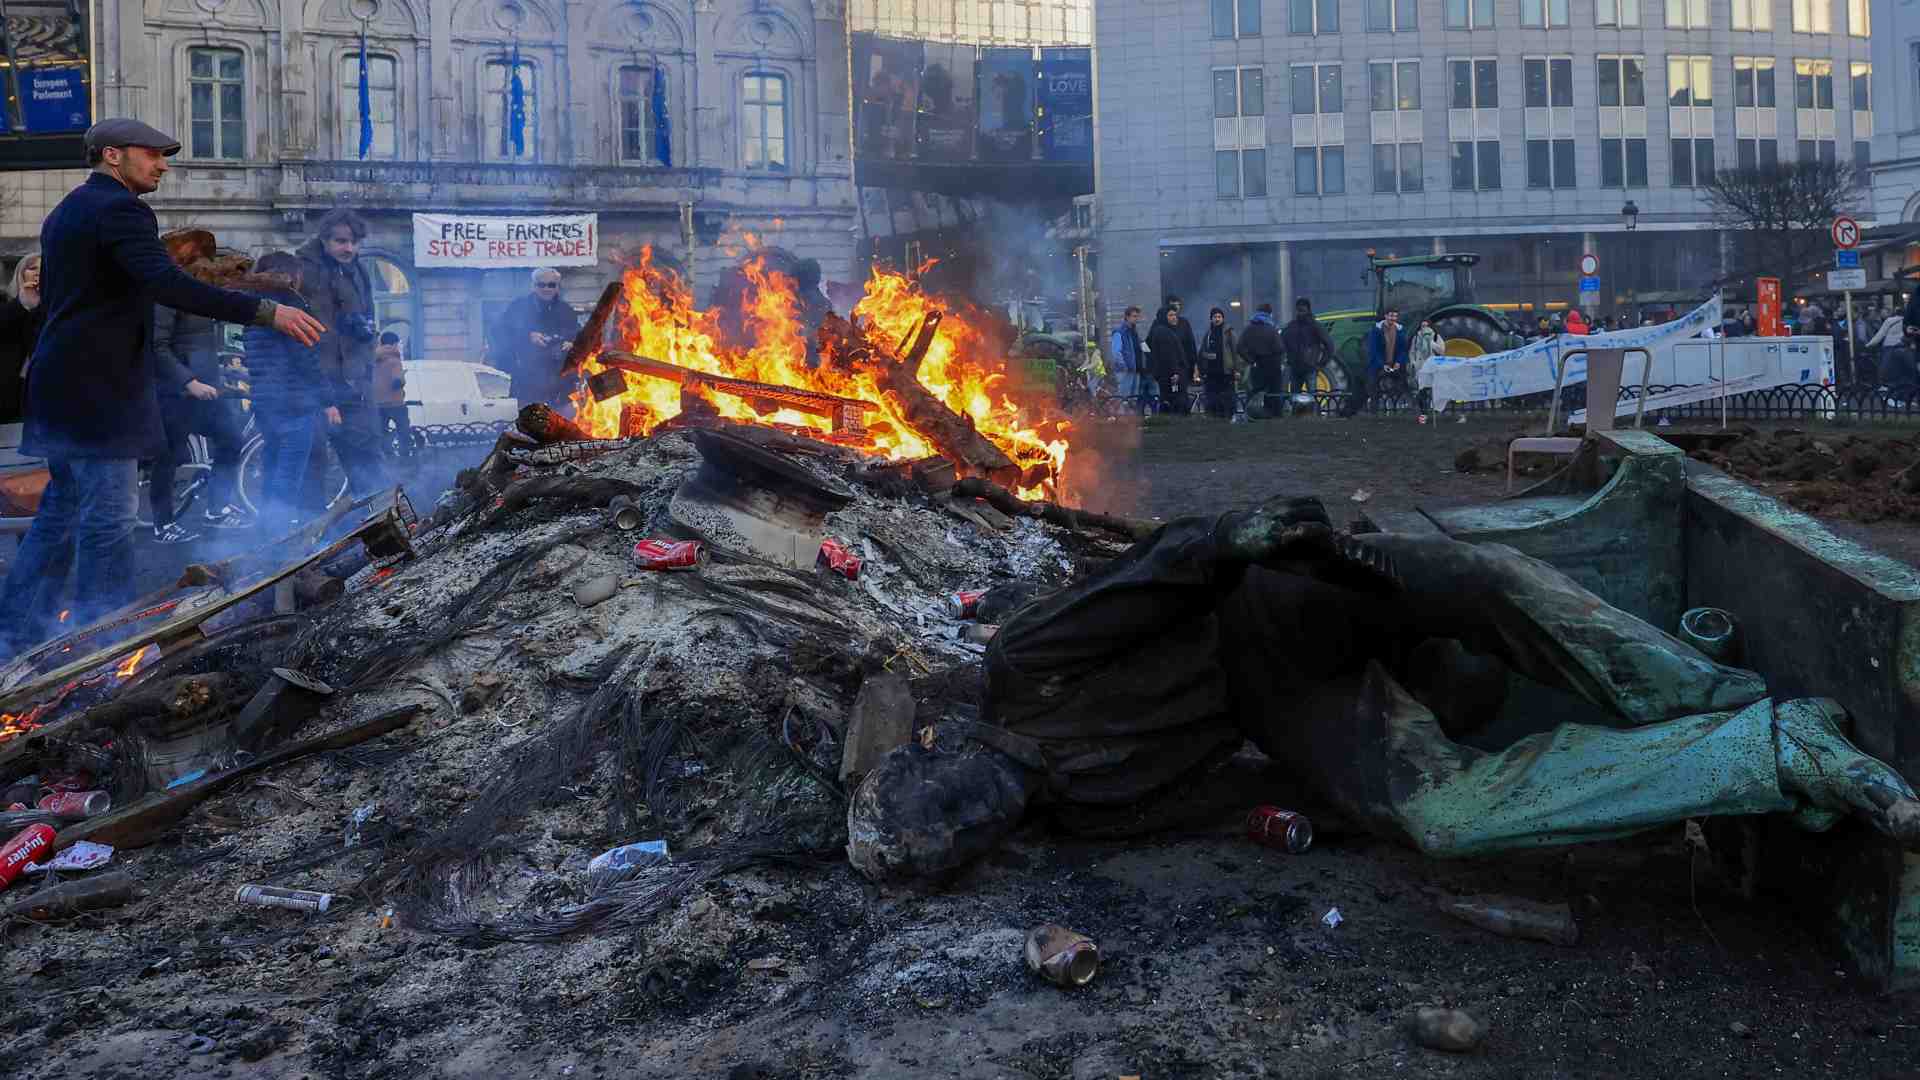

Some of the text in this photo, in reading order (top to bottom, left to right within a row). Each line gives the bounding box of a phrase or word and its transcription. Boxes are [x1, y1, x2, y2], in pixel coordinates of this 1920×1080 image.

[1048, 80, 1089, 94] LOVE
[441, 223, 584, 240] FREE FARMERS
[427, 224, 593, 258] STOP FREE TRADE!
